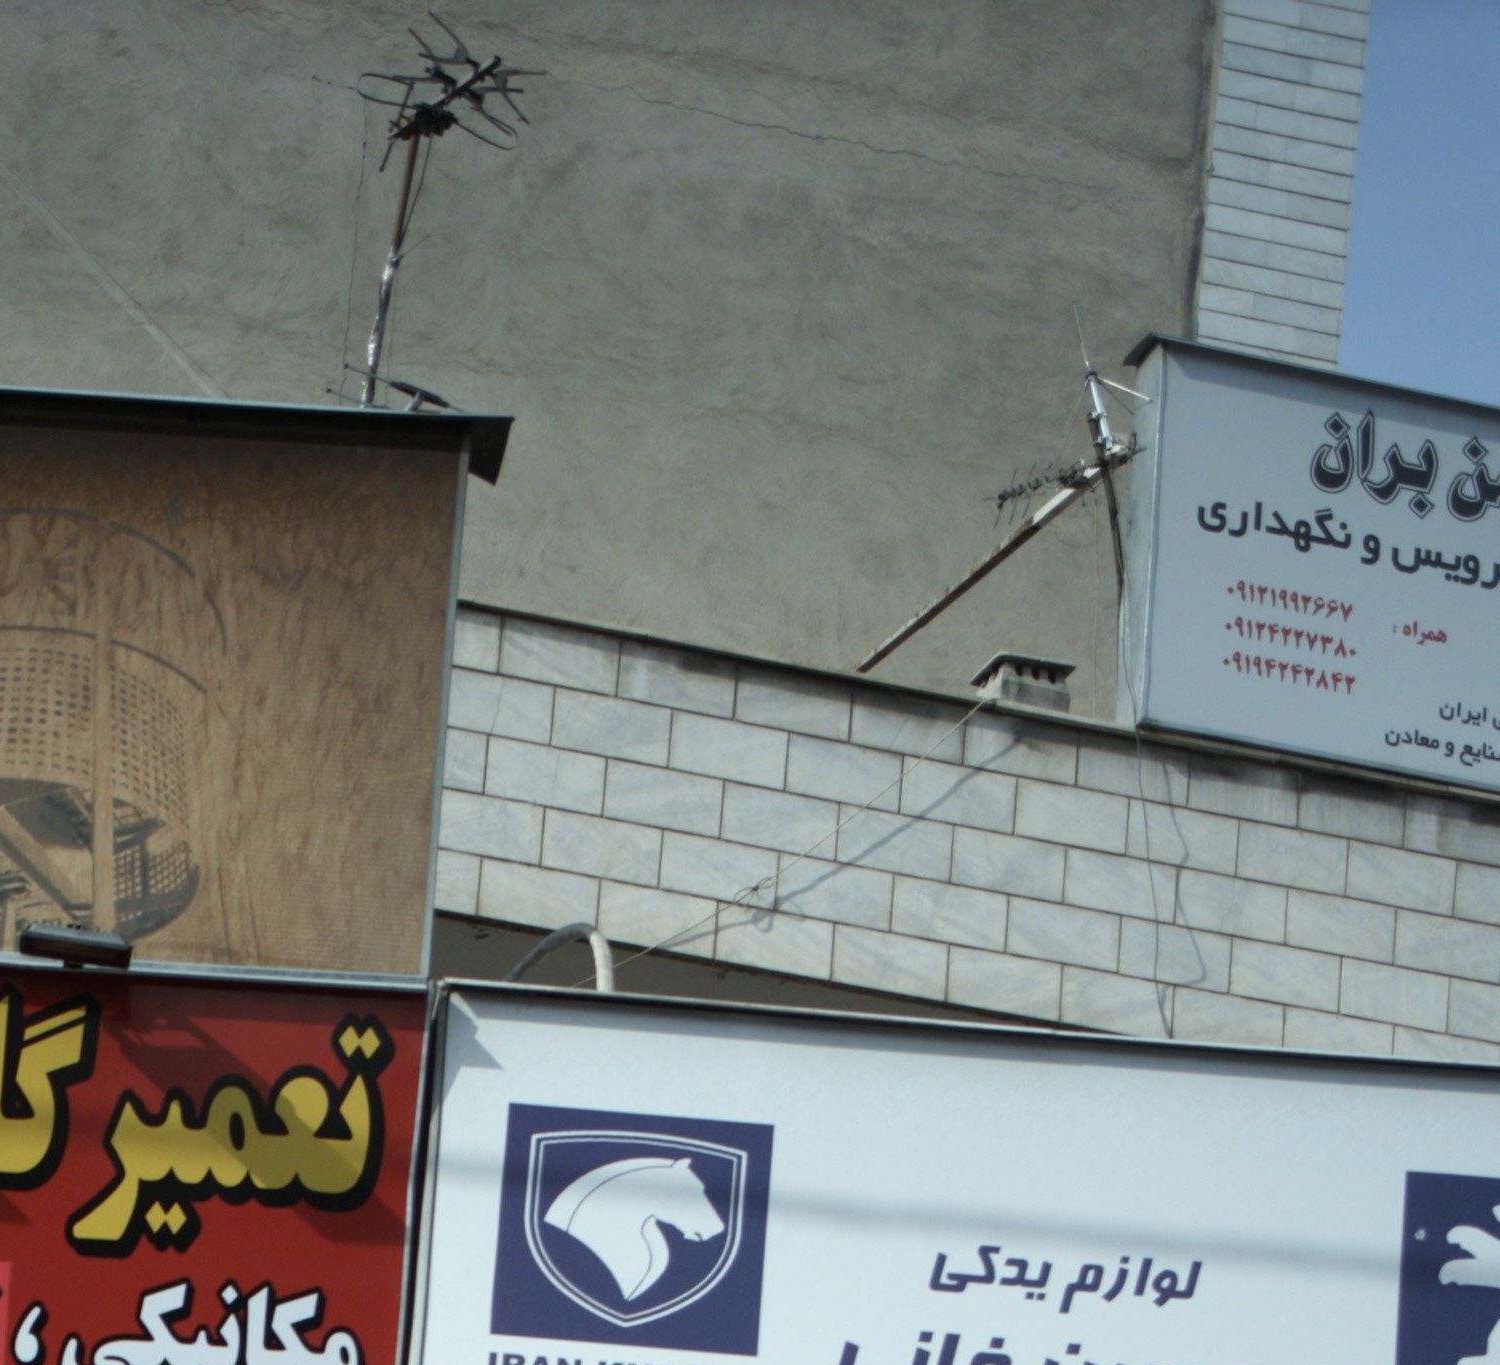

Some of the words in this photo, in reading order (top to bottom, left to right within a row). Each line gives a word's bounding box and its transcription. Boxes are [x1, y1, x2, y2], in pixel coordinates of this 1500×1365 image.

[1310, 408, 1440, 520] بران
[1197, 500, 1352, 554] نگهداری
[1360, 533, 1381, 566] و
[1384, 729, 1441, 748] معادن
[1439, 702, 1488, 727] ایران
[1443, 740, 1455, 758] و
[68, 1014, 396, 1256] تعمیر
[927, 1243, 1054, 1302] یدکی
[1056, 1254, 1204, 1315] لوازم
